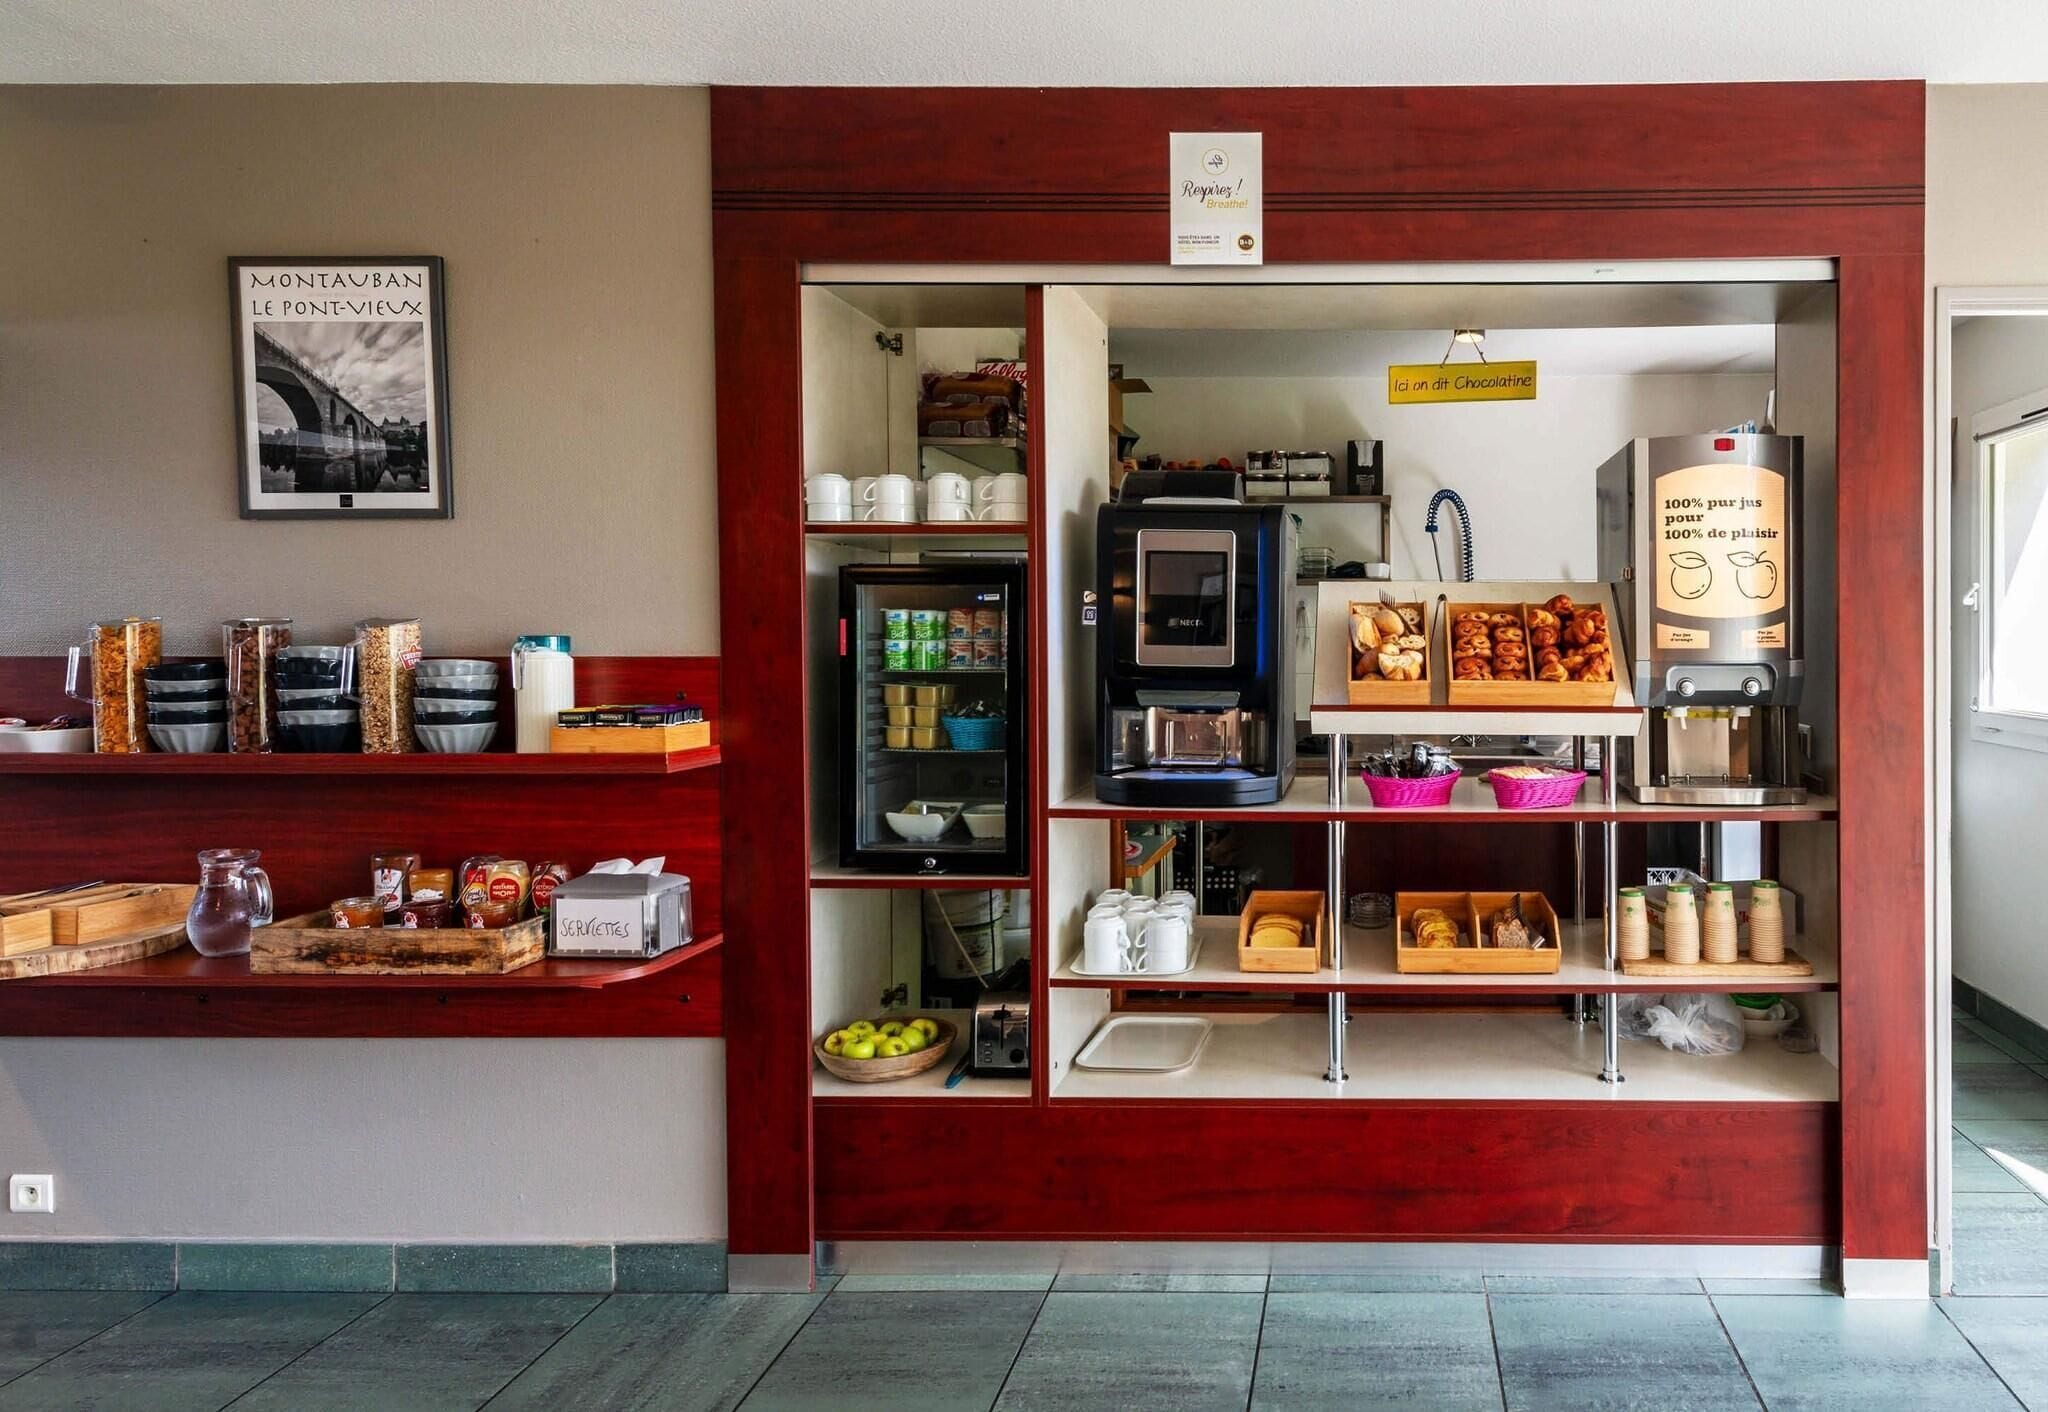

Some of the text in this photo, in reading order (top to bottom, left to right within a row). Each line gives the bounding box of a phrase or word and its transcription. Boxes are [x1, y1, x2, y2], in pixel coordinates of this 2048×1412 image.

[1206, 199, 1249, 209] Breathe!
[250, 273, 422, 288] MONTAUBAN
[253, 300, 423, 315] LE PONT-VIEUX
[1394, 374, 1532, 392] Ici on dit Chocolatine
[1665, 497, 1762, 510] 100% pur jus
[1665, 514, 1704, 526] pour
[1665, 528, 1778, 541] 100% de plaisir
[561, 917, 629, 938] SERVIETTES
